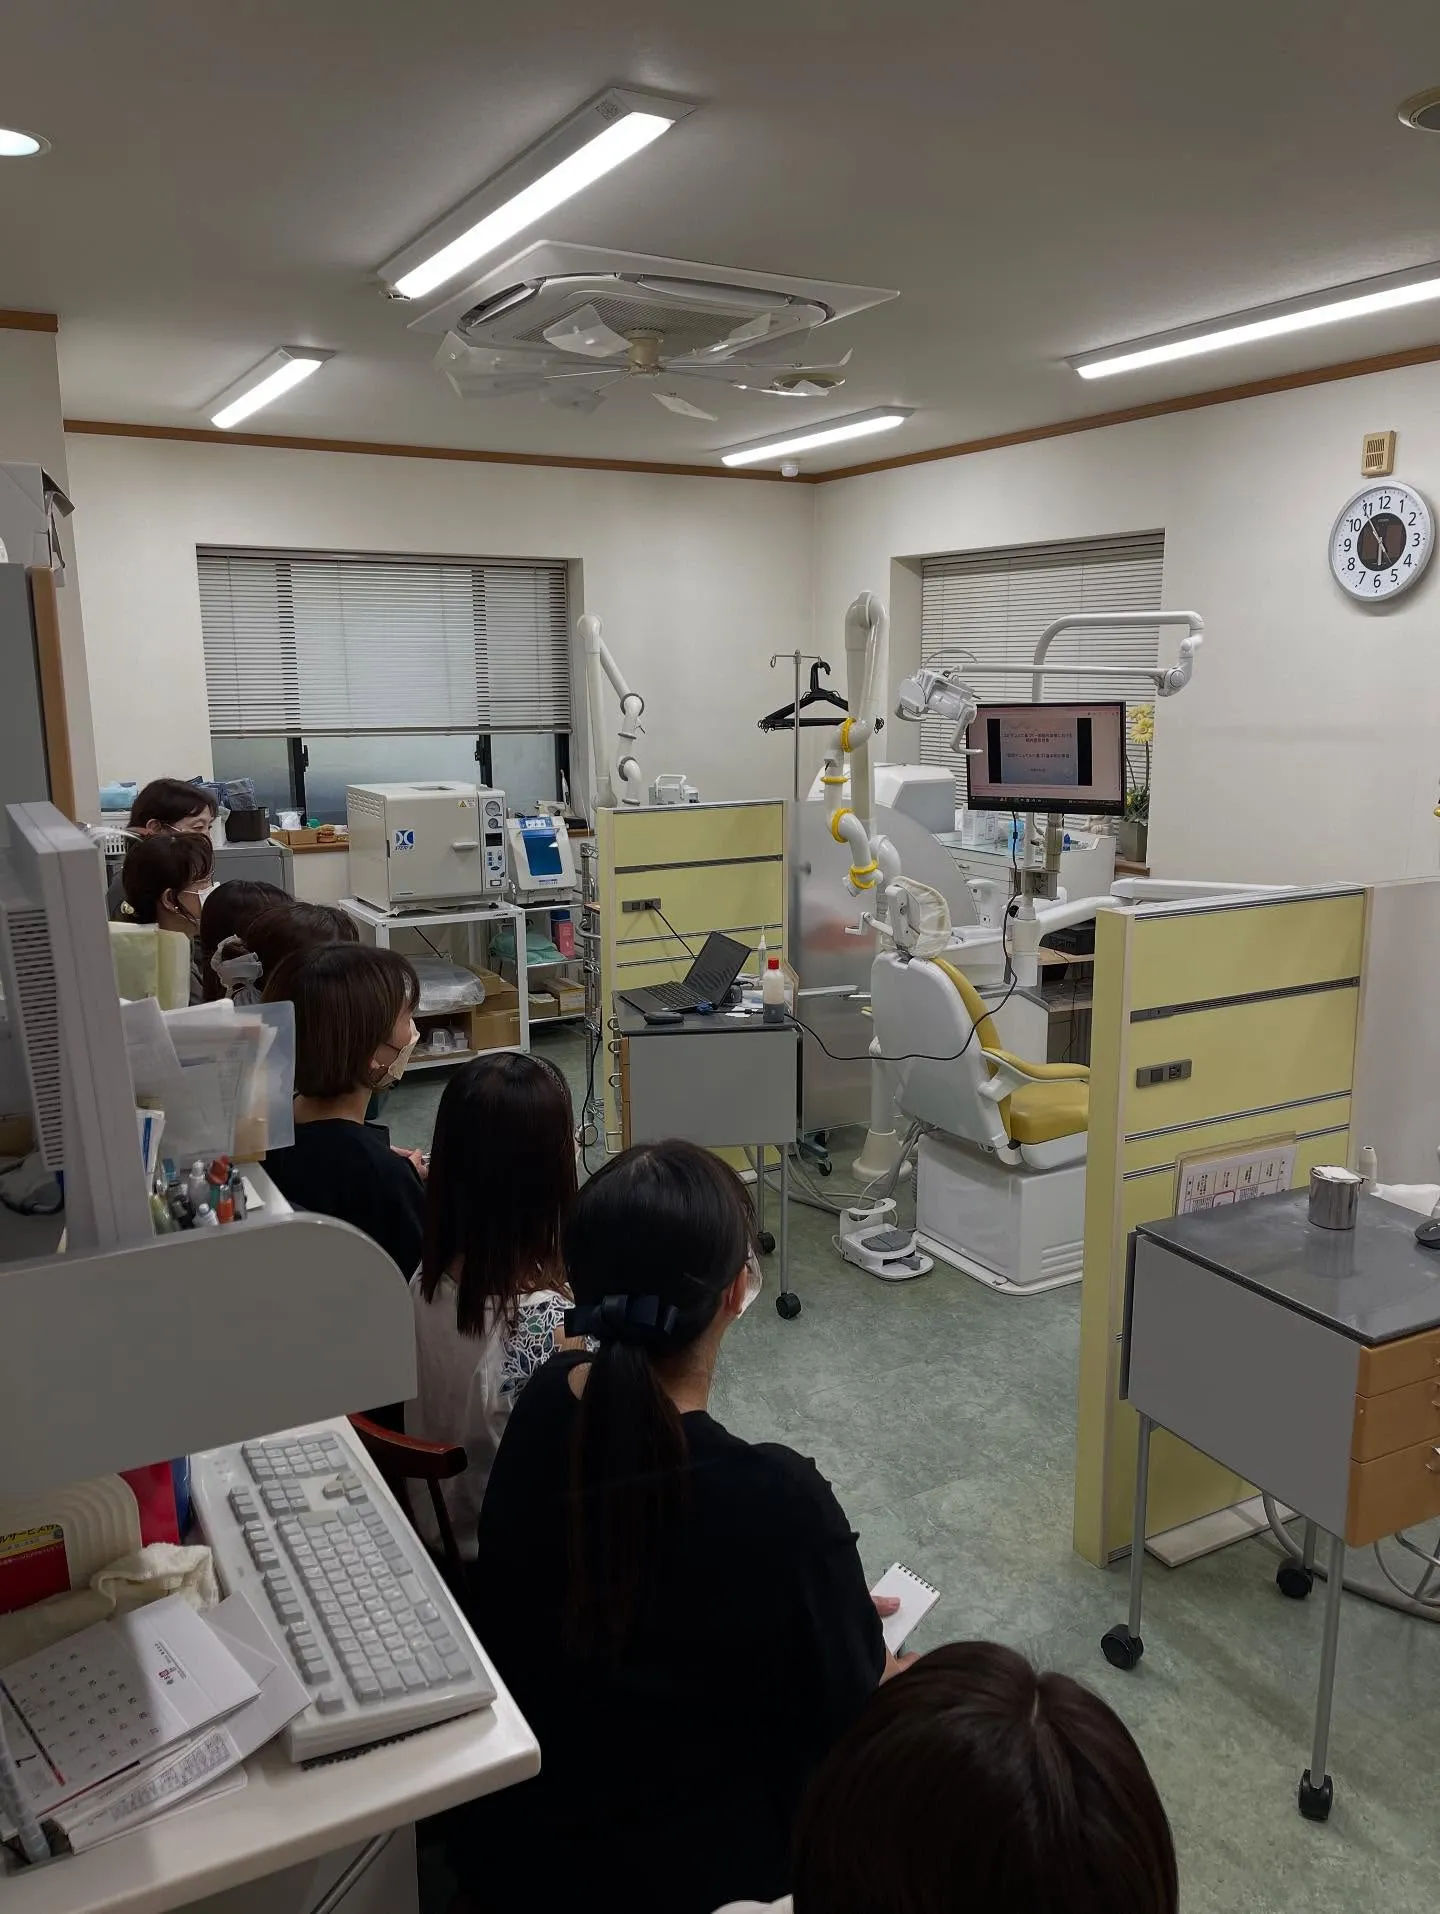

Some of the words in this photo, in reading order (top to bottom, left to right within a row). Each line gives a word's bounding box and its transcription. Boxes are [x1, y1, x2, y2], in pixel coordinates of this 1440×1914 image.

[1379, 495, 1391, 509] 12
[1400, 499, 1404, 513] 1
[1363, 503, 1373, 517] 11
[1350, 518, 1361, 532] 10
[1408, 512, 1417, 526] 2
[1344, 538, 1351, 552] 9
[1412, 533, 1421, 547] 3
[1347, 557, 1356, 571] 8
[1403, 554, 1412, 567] 4
[1358, 571, 1366, 585] 7
[1374, 574, 1381, 588] 6
[1390, 569, 1398, 582] 5
[15, 1754, 37, 1768] 7
